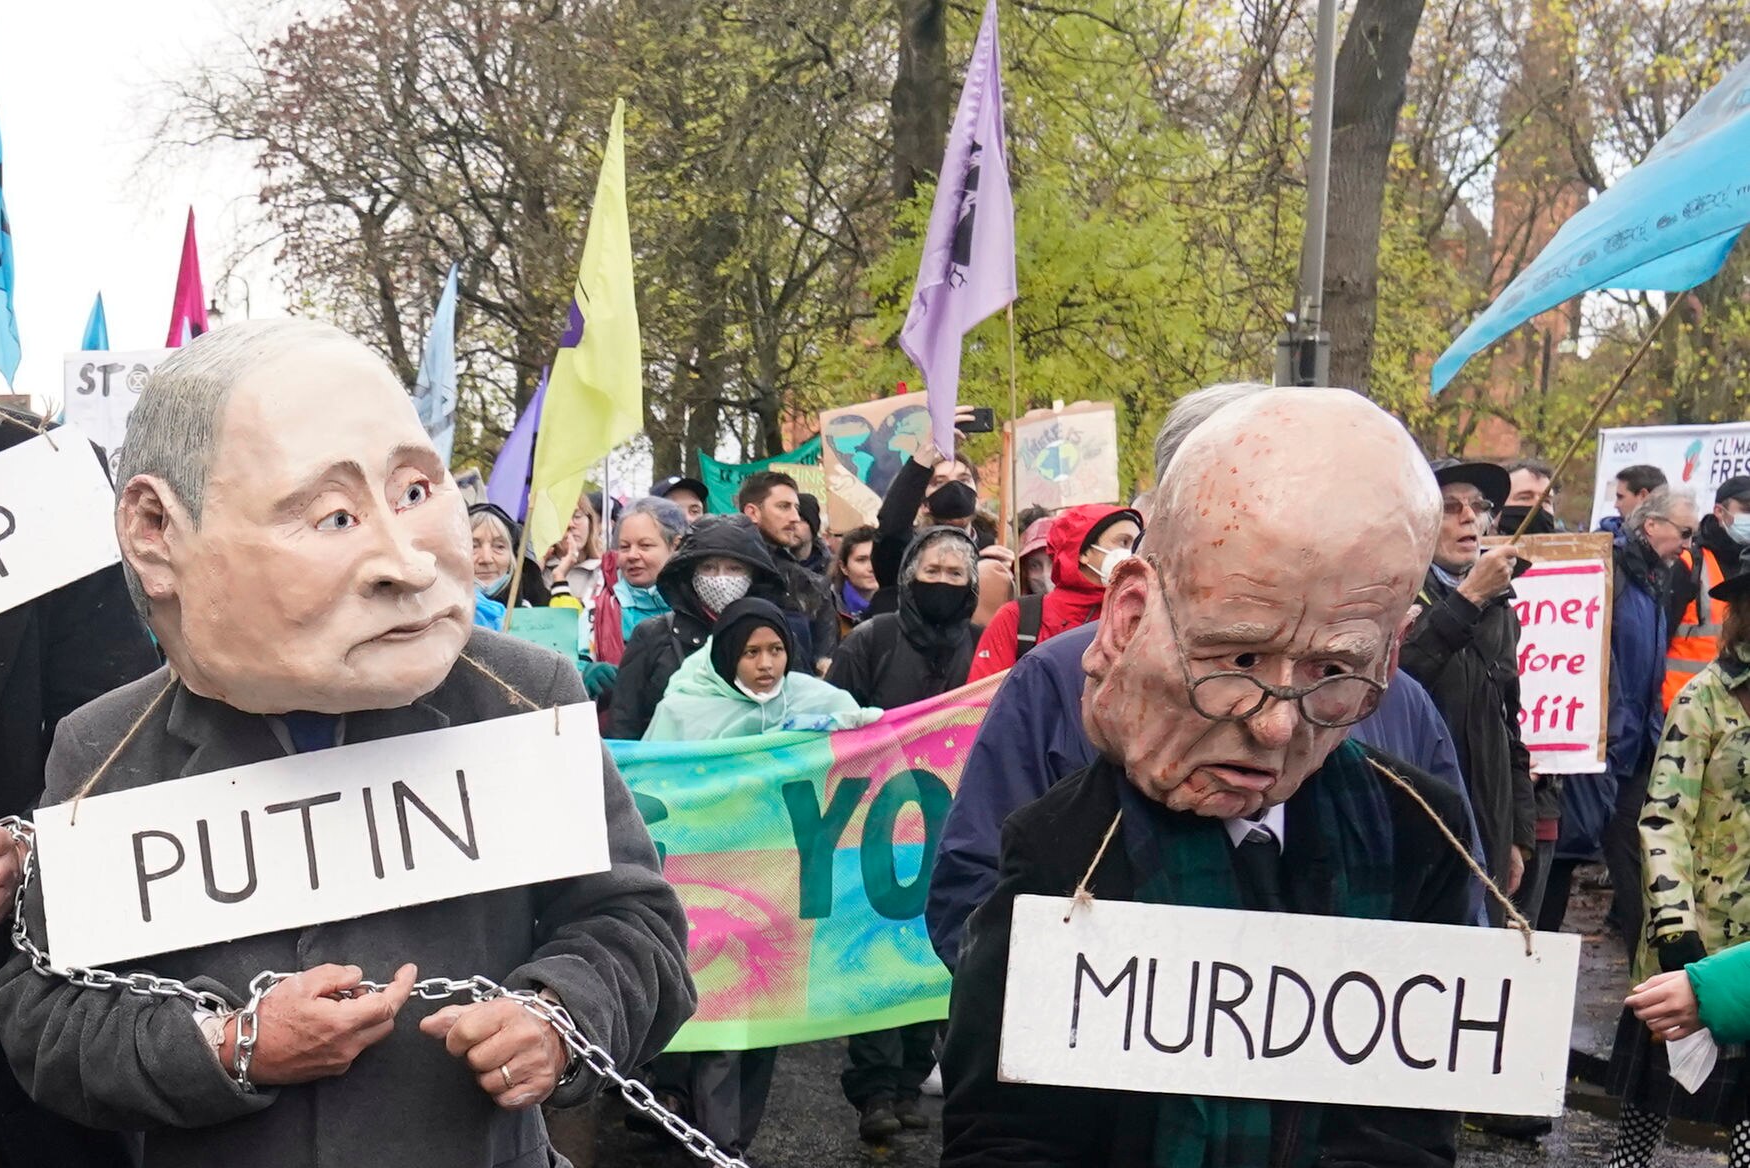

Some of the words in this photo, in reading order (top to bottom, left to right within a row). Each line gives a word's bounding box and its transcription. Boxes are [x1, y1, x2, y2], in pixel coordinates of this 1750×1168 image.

[76, 362, 149, 398] STO
[1514, 596, 1600, 629] anet
[1517, 643, 1586, 677] fore
[1516, 695, 1584, 733] ofit
[131, 769, 481, 923] PUTIN
[782, 769, 955, 920] YO
[1070, 952, 1513, 1075] MURDOCH
